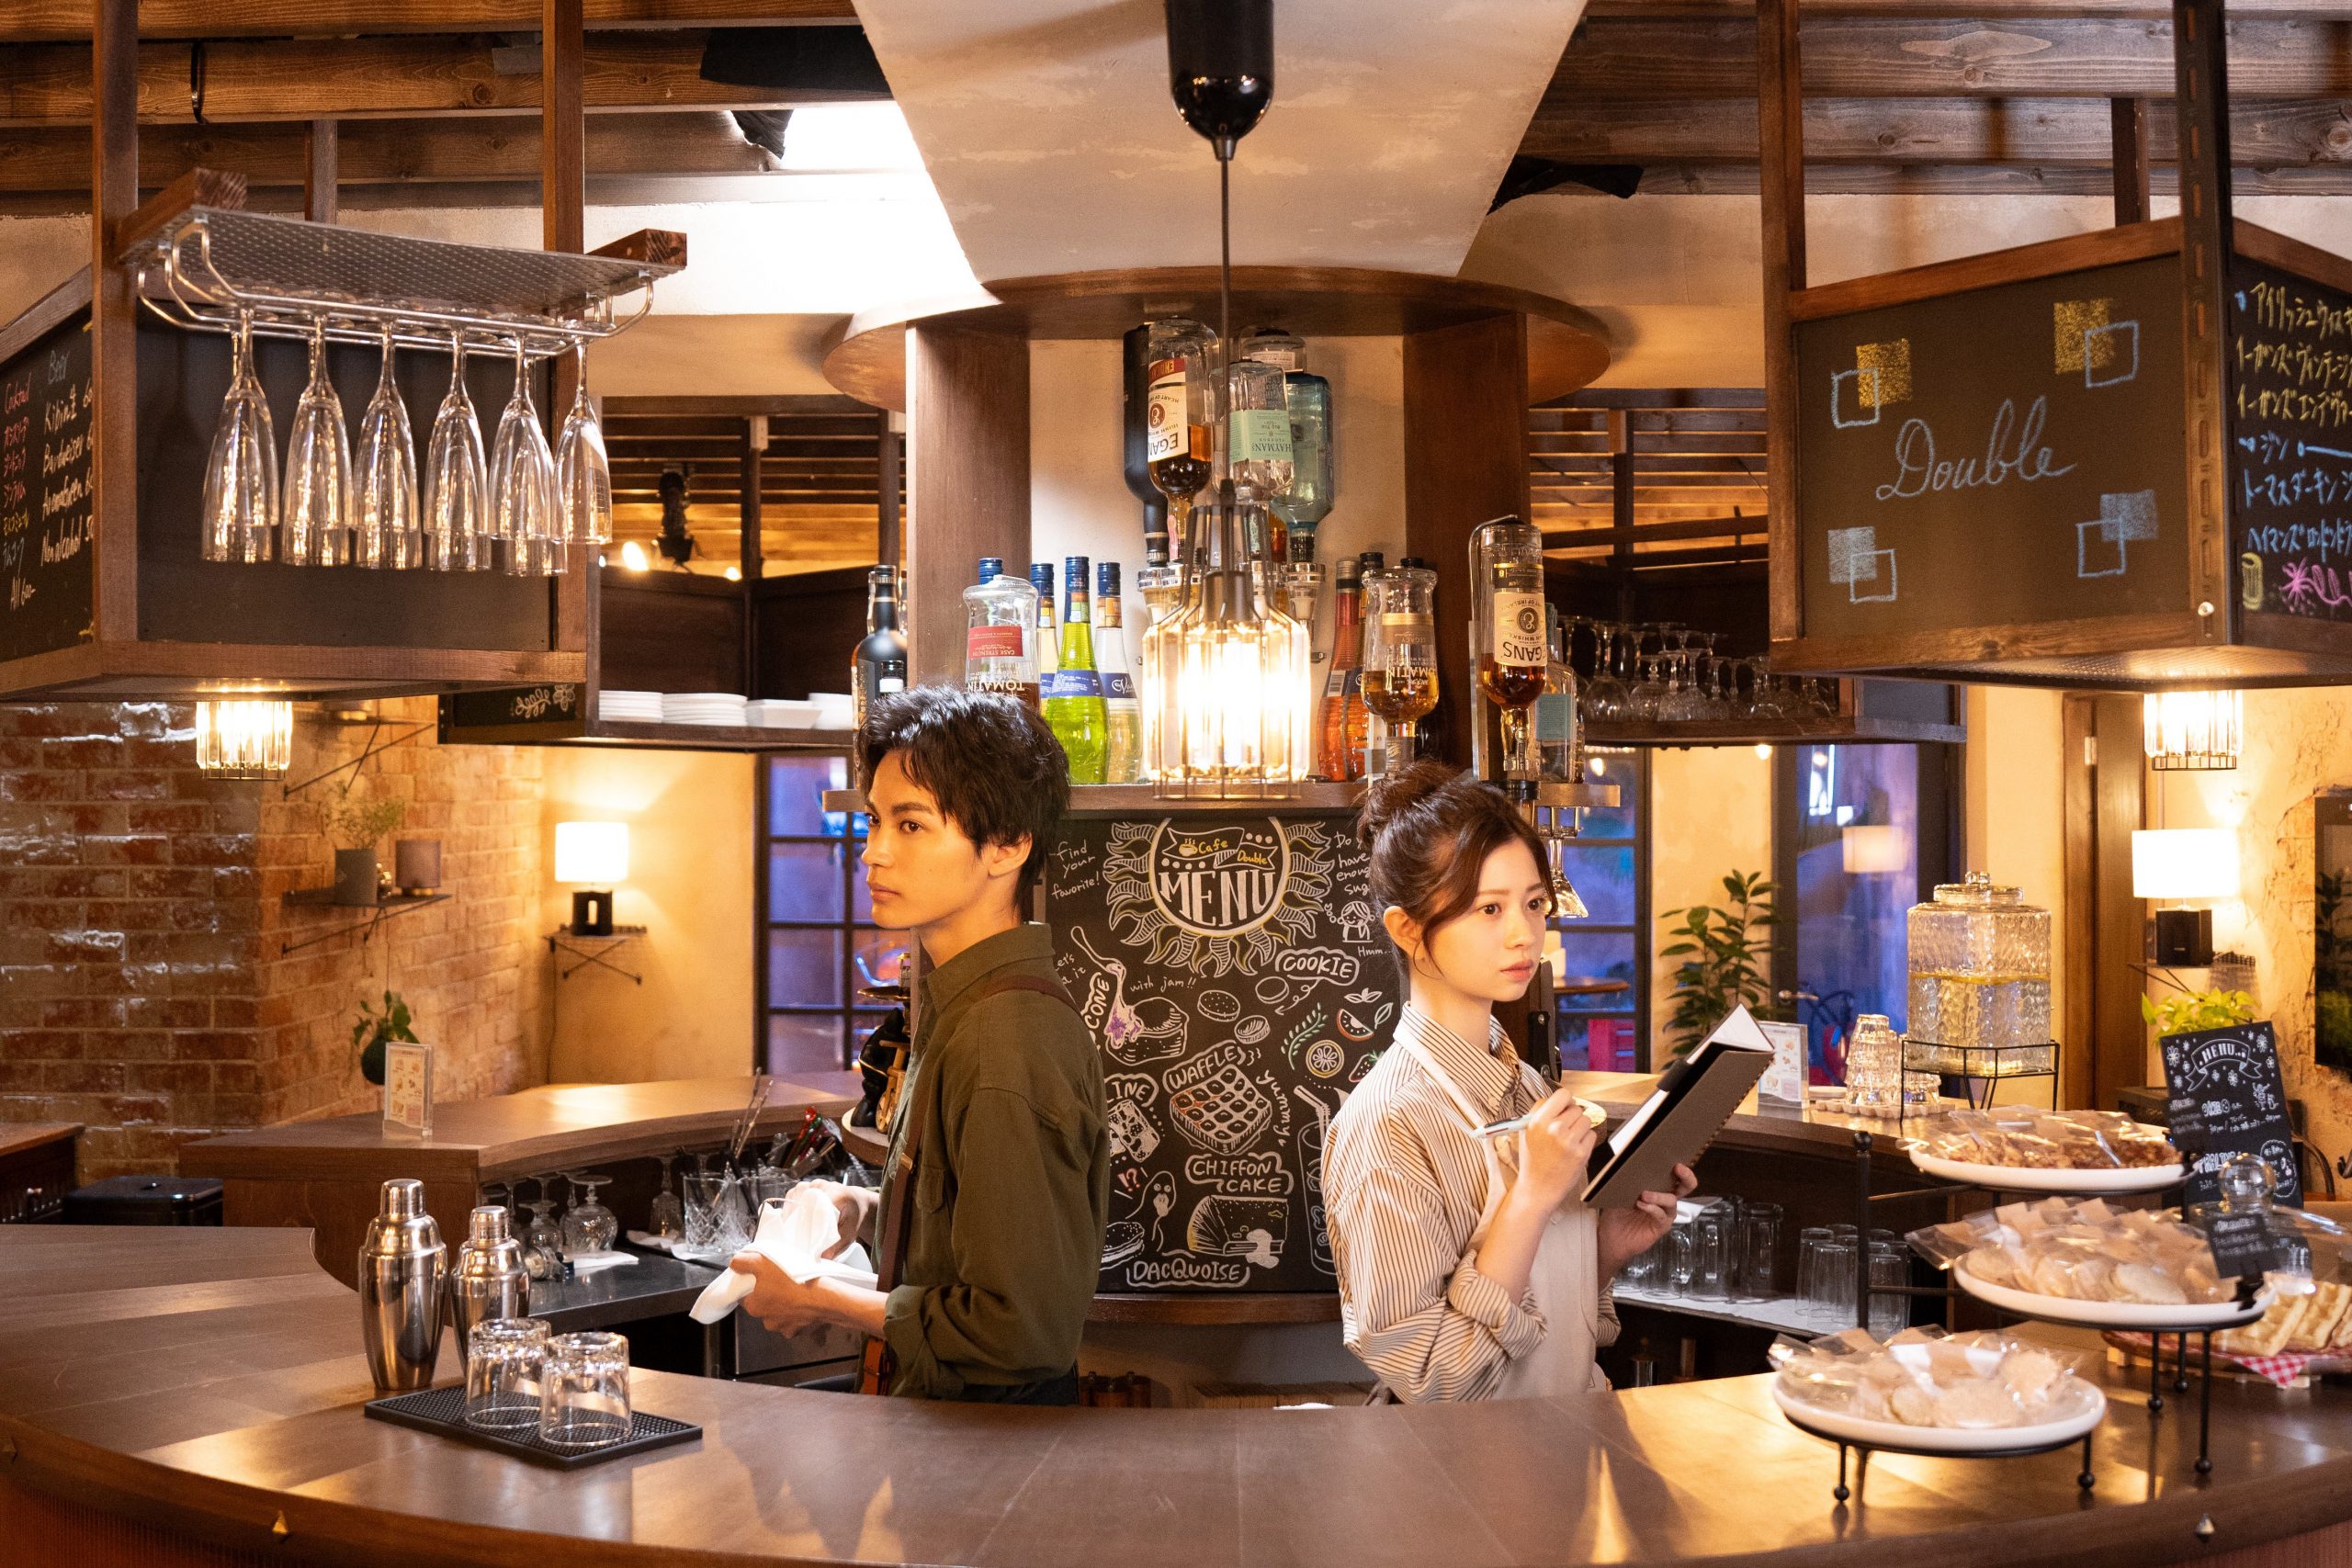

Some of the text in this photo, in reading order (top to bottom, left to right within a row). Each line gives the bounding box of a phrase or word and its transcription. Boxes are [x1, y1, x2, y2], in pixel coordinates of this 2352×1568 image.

[1876, 395, 2076, 502] Double
[1198, 839, 1228, 855] Cafe
[1334, 830, 1352, 849] Do
[1062, 855, 1096, 879] your
[1237, 849, 1268, 865] Double
[1338, 852, 1371, 869] have
[1336, 865, 1371, 882] enoug
[1051, 870, 1101, 900] favorite!
[1159, 870, 1276, 929] MENU
[1283, 956, 1354, 979] COOKIE
[1129, 975, 1154, 992] with
[1084, 977, 1110, 1030] CONE
[1168, 1043, 1239, 1089] WAFFLE
[1193, 1159, 1272, 1176] CHIFFON
[1226, 1178, 1283, 1193] CAKE
[1132, 1258, 1242, 1281] DACQUOISE
